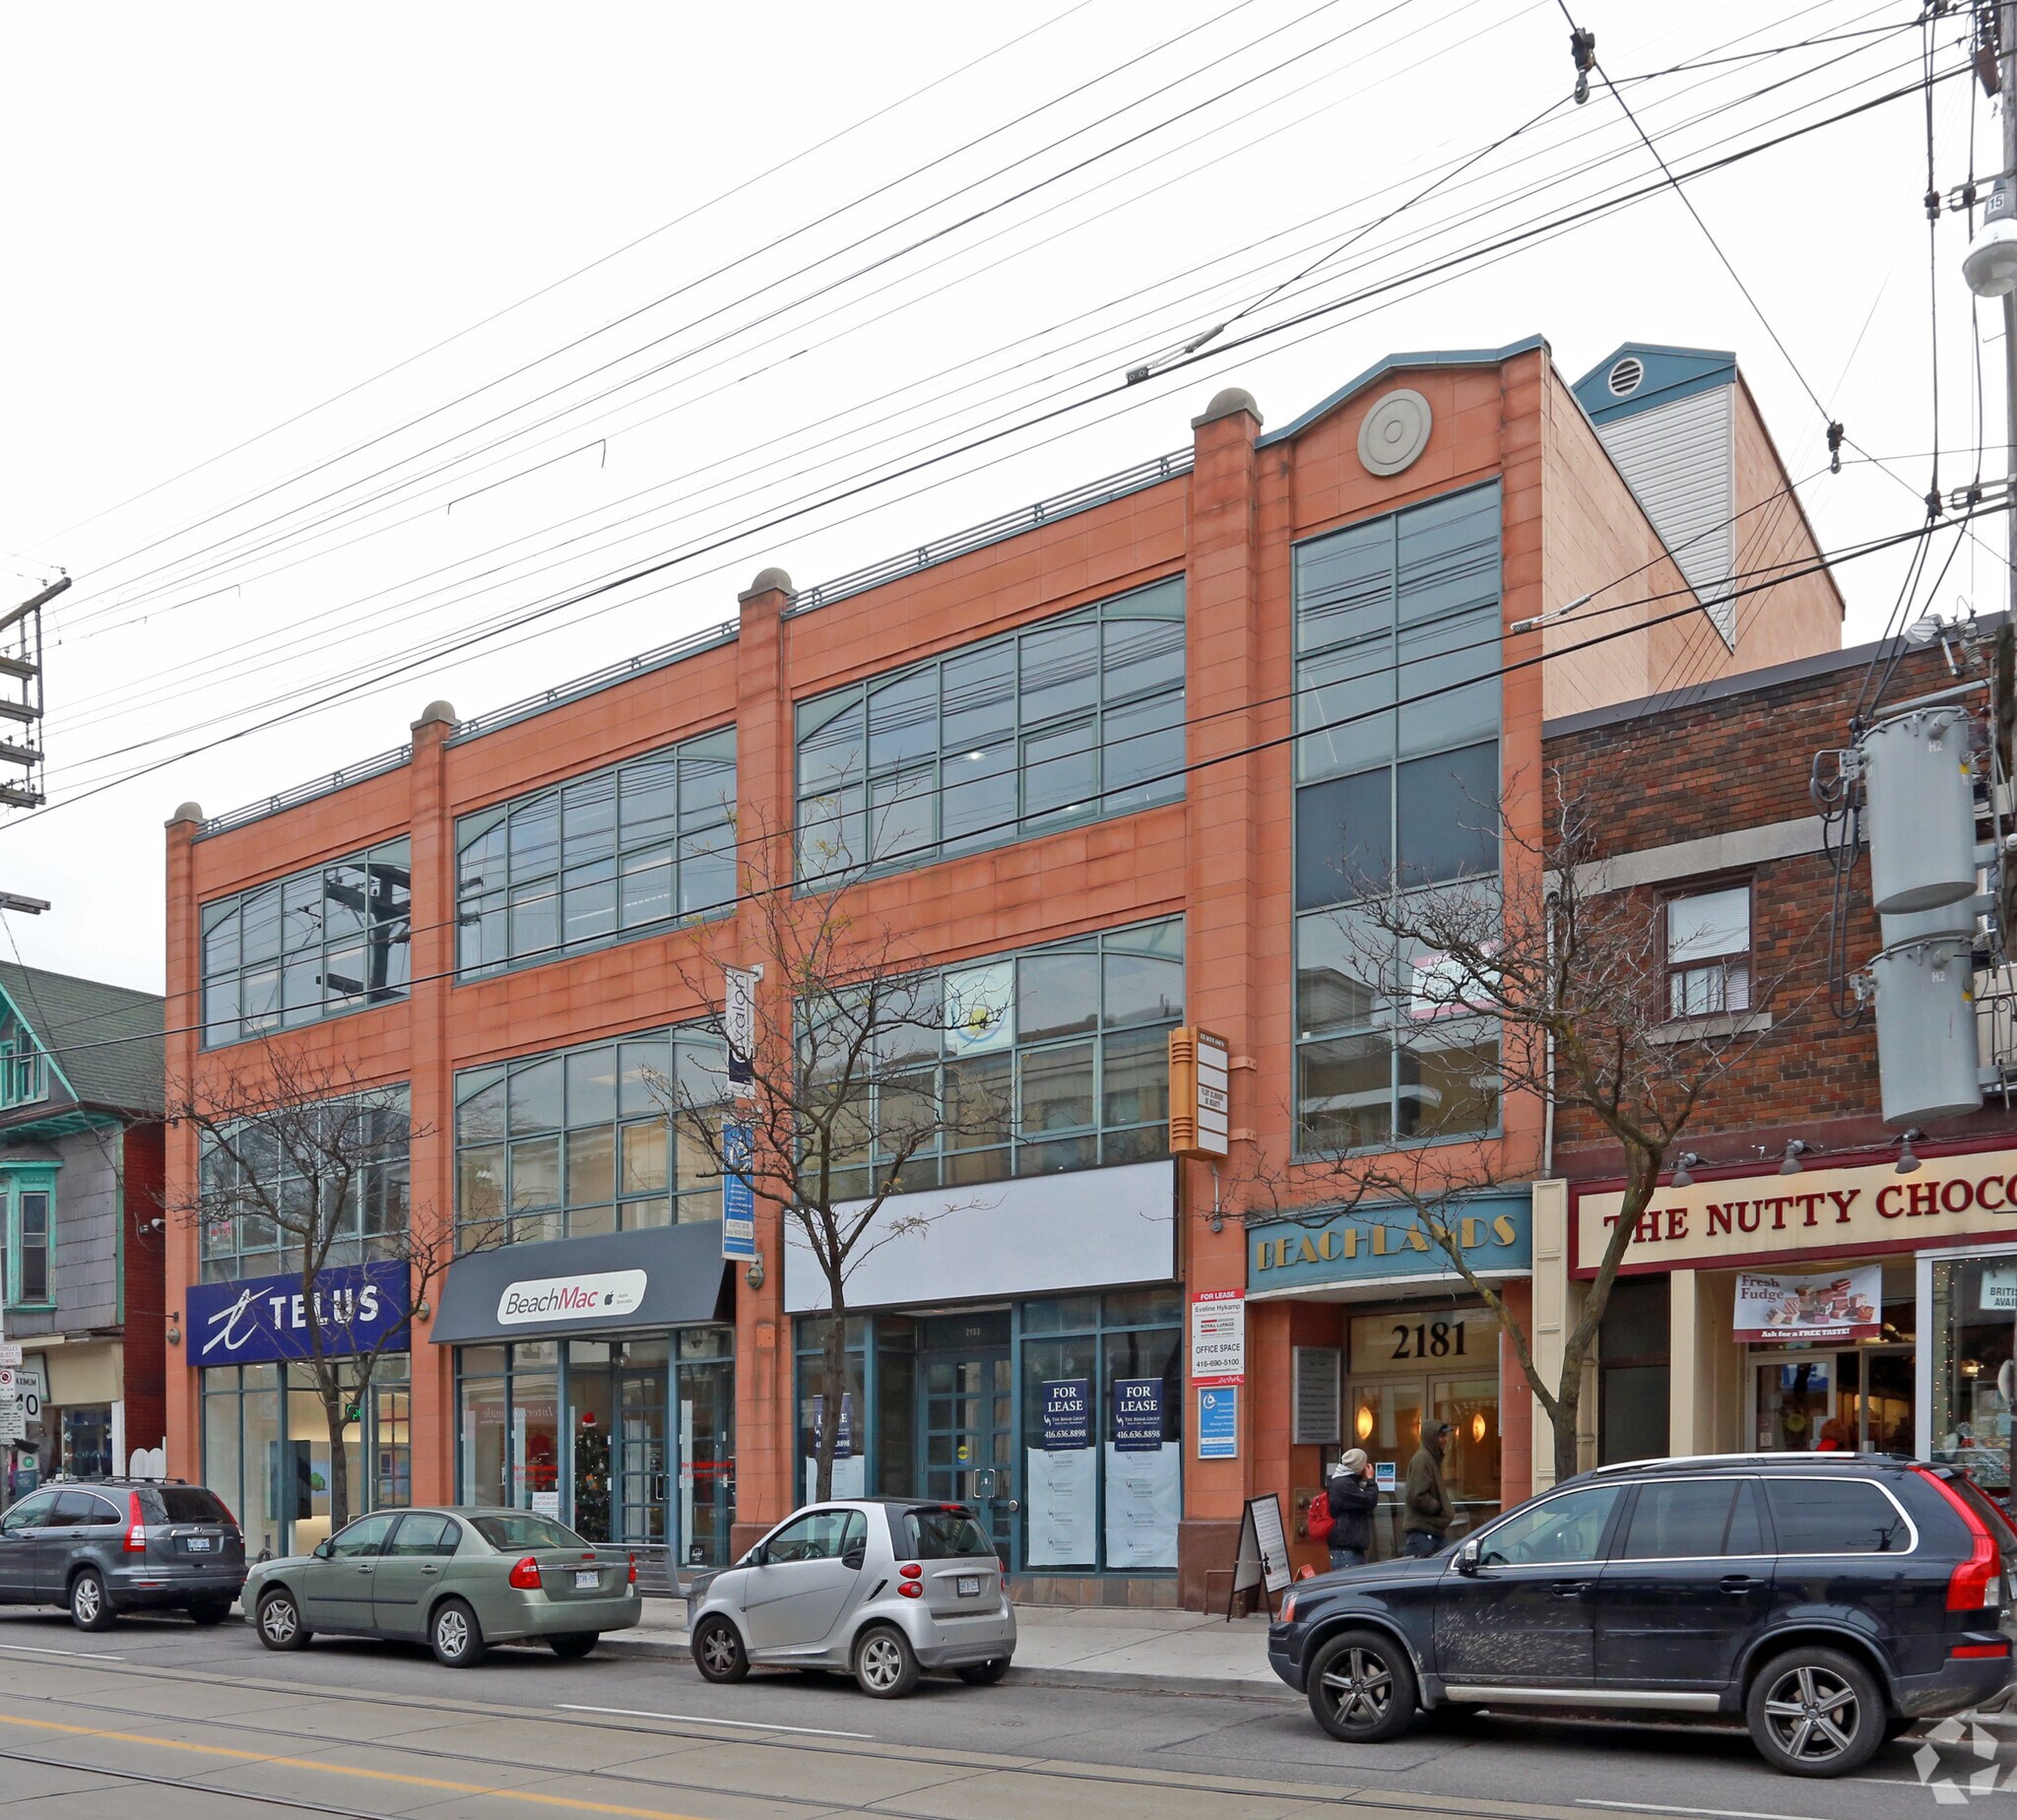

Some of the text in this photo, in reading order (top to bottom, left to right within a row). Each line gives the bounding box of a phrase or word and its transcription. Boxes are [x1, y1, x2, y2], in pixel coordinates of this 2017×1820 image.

[1989, 195, 2003, 210] 15
[1928, 741, 1942, 752] H2
[1931, 971, 1946, 983] H2
[1706, 1189, 1861, 1236] NUTTY
[1741, 1274, 1780, 1287] Fresh
[505, 1286, 599, 1315] BeachMac
[1740, 1287, 1784, 1303] Fudge
[269, 1285, 379, 1330] TELUS
[1216, 1303, 1241, 1312] Hykamp
[1391, 1321, 1468, 1360] 2181
[1196, 1342, 1241, 1354] OFFICE SPACE
[1196, 1358, 1240, 1368] 416-690-5100
[16, 1378, 36, 1387] AXIMUM
[1053, 1387, 1077, 1398] FOR
[1126, 1386, 1151, 1398] FOR
[1048, 1399, 1083, 1412] LEASE
[1121, 1399, 1158, 1412] LEASE
[1044, 1429, 1086, 1439] 416.636.8898
[1116, 1430, 1161, 1439] 416.636.8898
